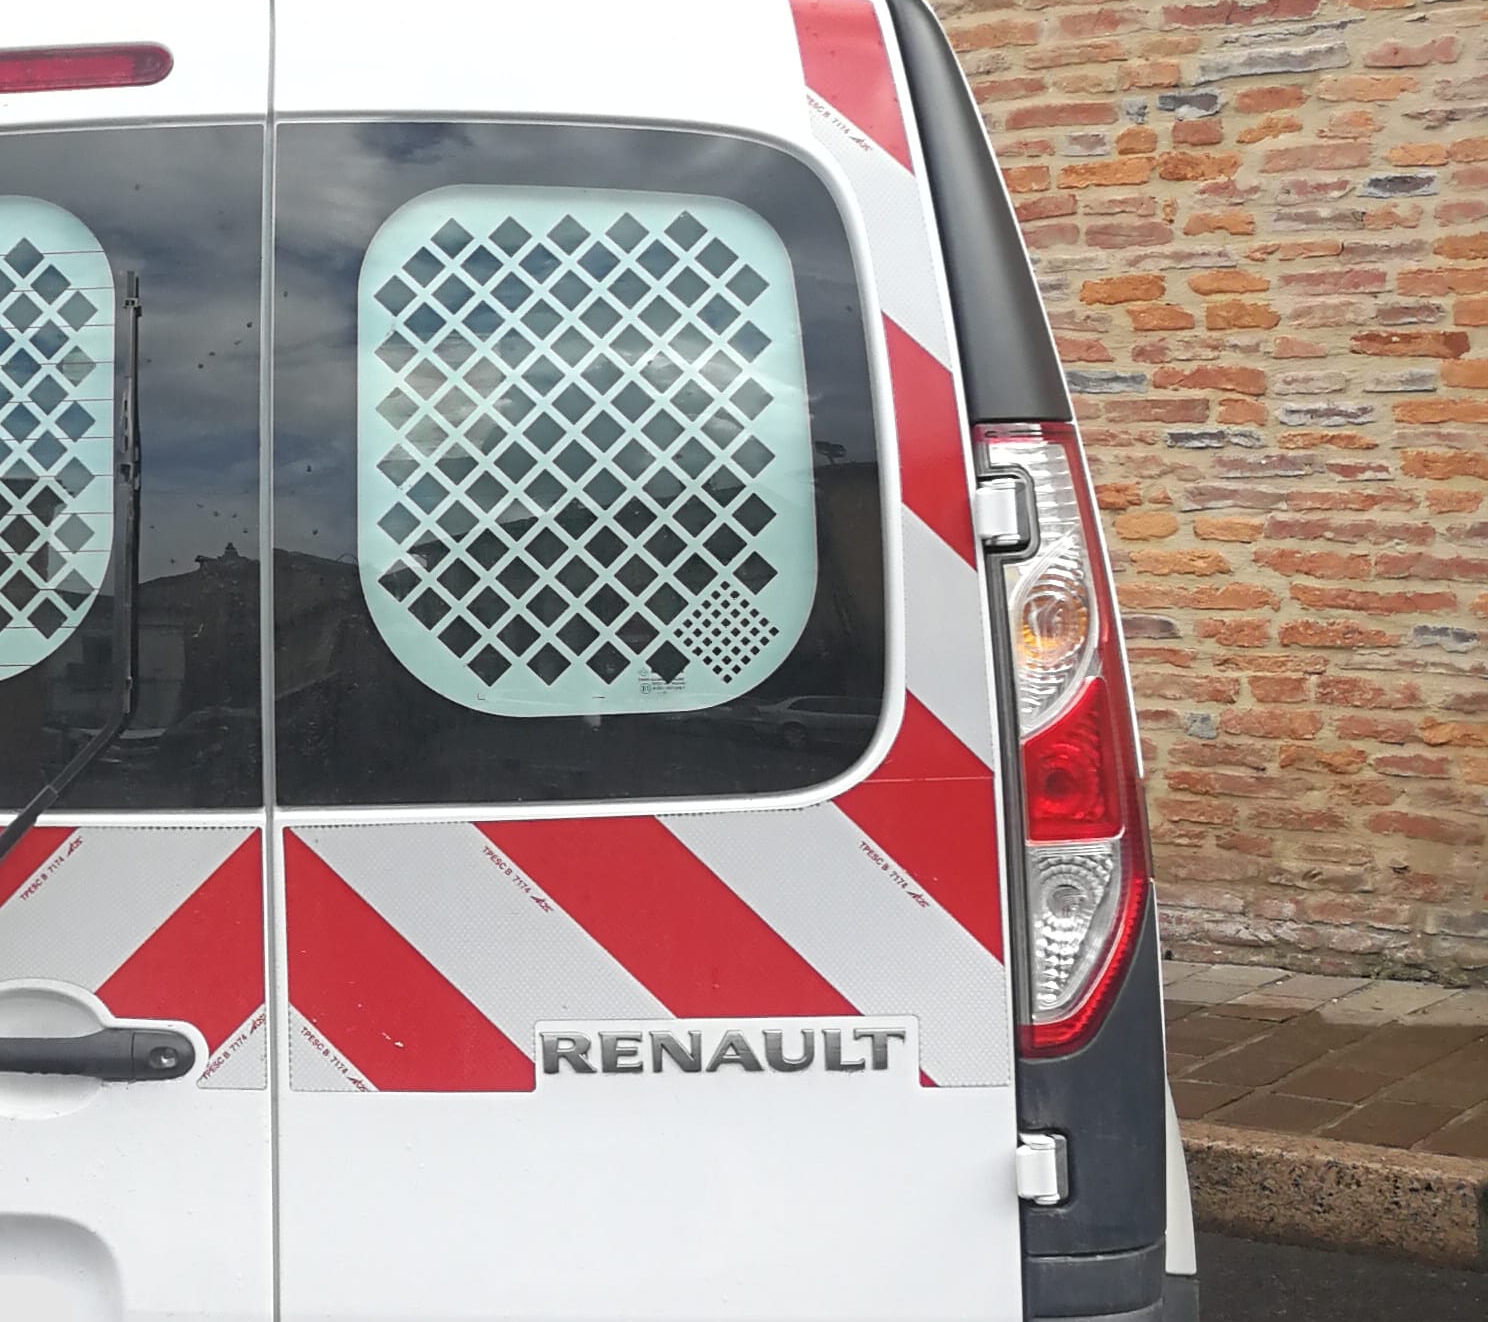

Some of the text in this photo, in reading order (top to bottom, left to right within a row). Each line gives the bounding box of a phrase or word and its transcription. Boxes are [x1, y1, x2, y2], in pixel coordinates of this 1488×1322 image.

[19, 878, 43, 901] TPESC
[47, 855, 65, 873] 7174
[482, 845, 531, 893] TPESC B 7174
[859, 841, 908, 889] TPESC B 7174
[202, 1034, 248, 1080] TPESC B 7174
[301, 1026, 325, 1051] TPESC
[330, 1055, 349, 1074] 7174
[539, 1028, 906, 1074] RENAULT
